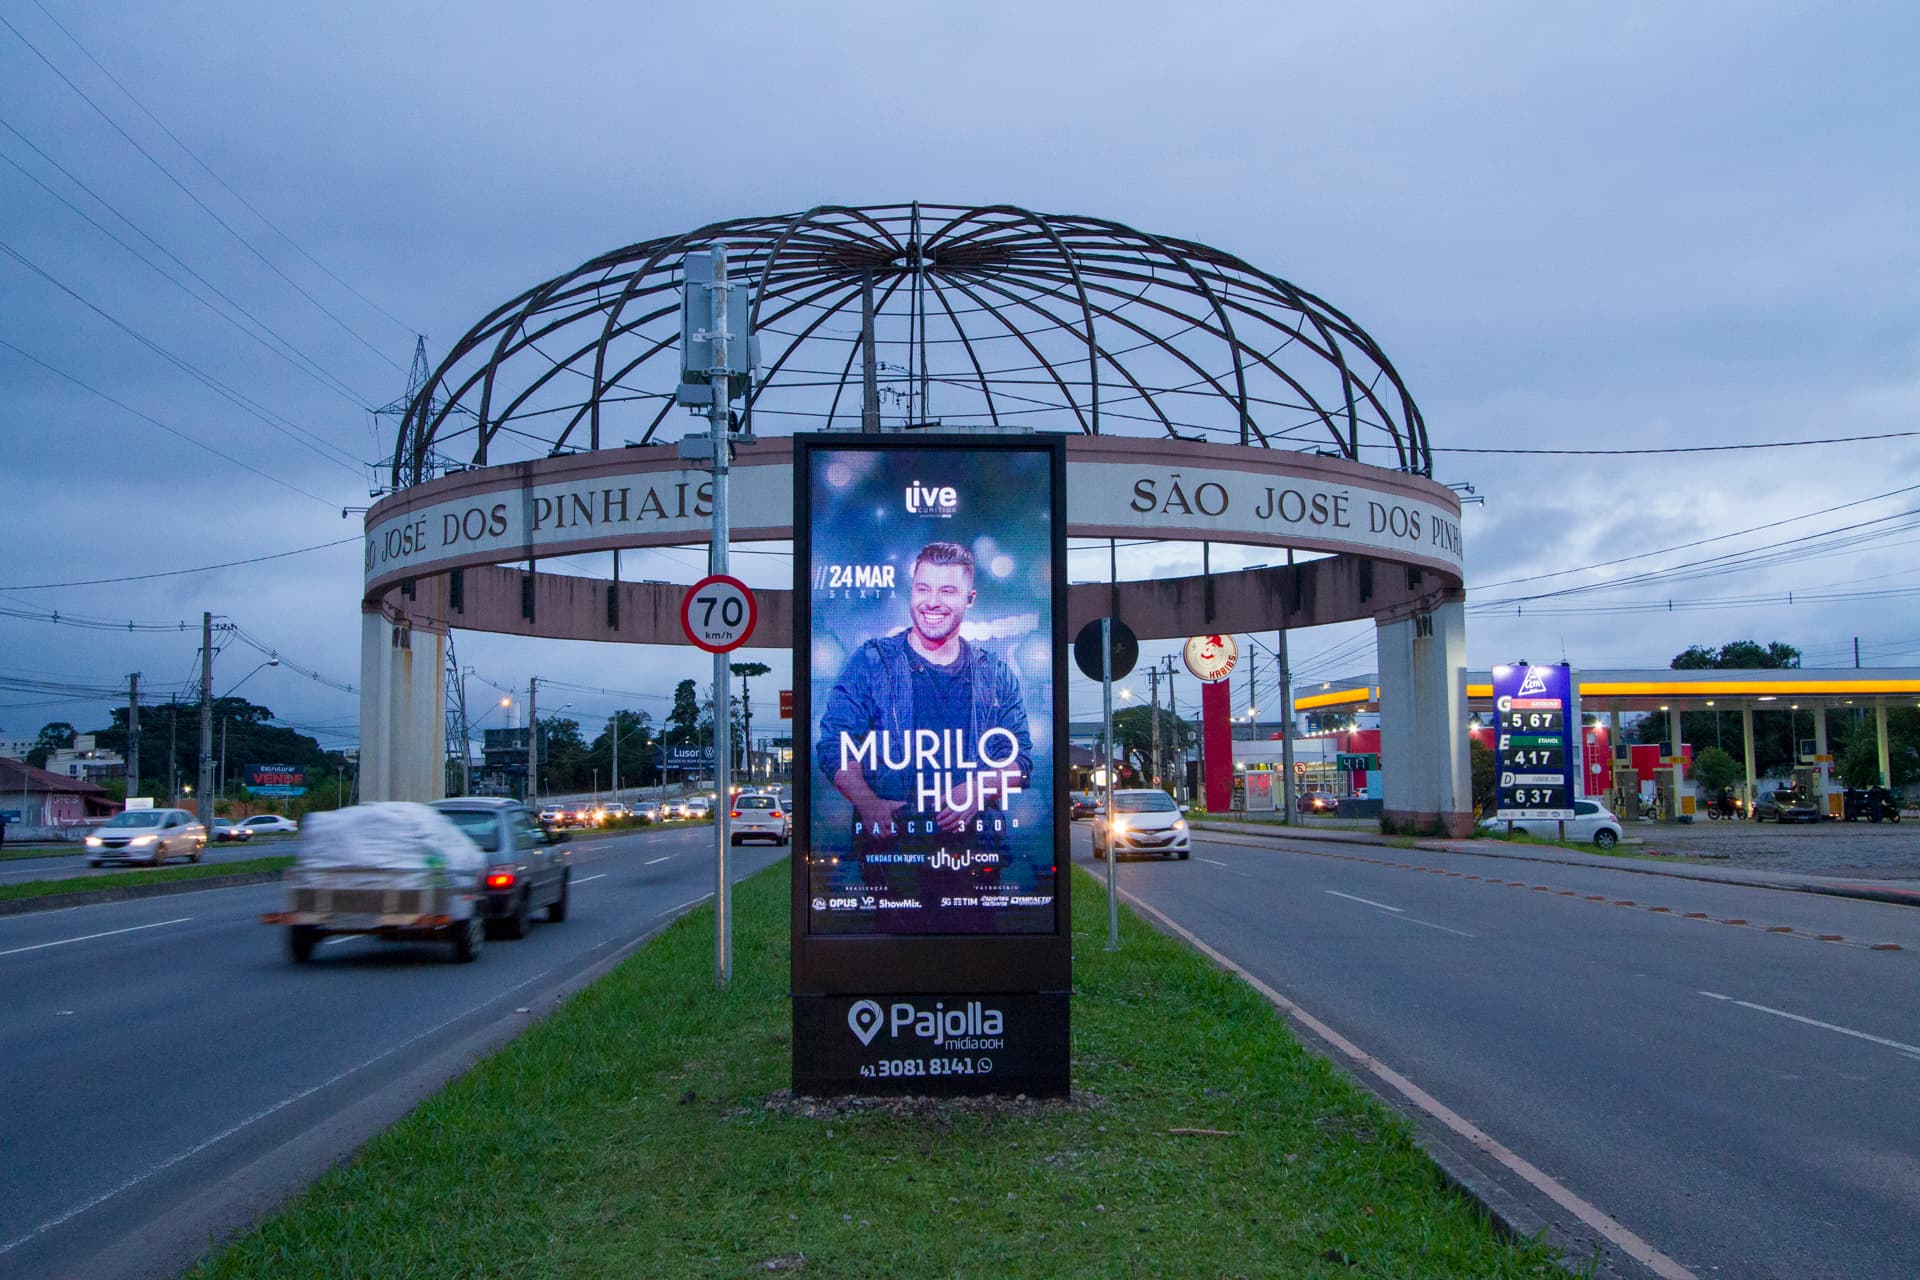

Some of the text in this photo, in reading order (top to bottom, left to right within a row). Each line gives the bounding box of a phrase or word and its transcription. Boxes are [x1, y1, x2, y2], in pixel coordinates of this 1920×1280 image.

[905, 480, 957, 513] live
[381, 513, 427, 562] JOSÉ
[442, 504, 508, 546] DOS
[532, 482, 713, 531] PINHAIS
[1130, 474, 1463, 561] SÃO JOSÉ DOS PINH
[829, 565, 895, 588] 24 MAR
[829, 590, 896, 599] SEXTA
[697, 597, 743, 627] 70
[705, 631, 733, 640] km/h
[1497, 695, 1512, 712] G
[1512, 713, 1553, 732] 5,67
[839, 727, 1020, 772] MURILO
[1499, 734, 1511, 750] E
[253, 773, 305, 785] VENDE
[1500, 771, 1516, 788] D
[917, 770, 1023, 813] HUFF
[1515, 789, 1553, 808] 6,37
[855, 820, 934, 835] PALCO
[866, 854, 892, 863] VENDAS
[829, 898, 858, 908] OPUS
[963, 897, 978, 906] TIM
[890, 1001, 1004, 1045] Pajolla
[979, 1038, 1004, 1049] OOH
[860, 1057, 974, 1077] 41 3081 8141
